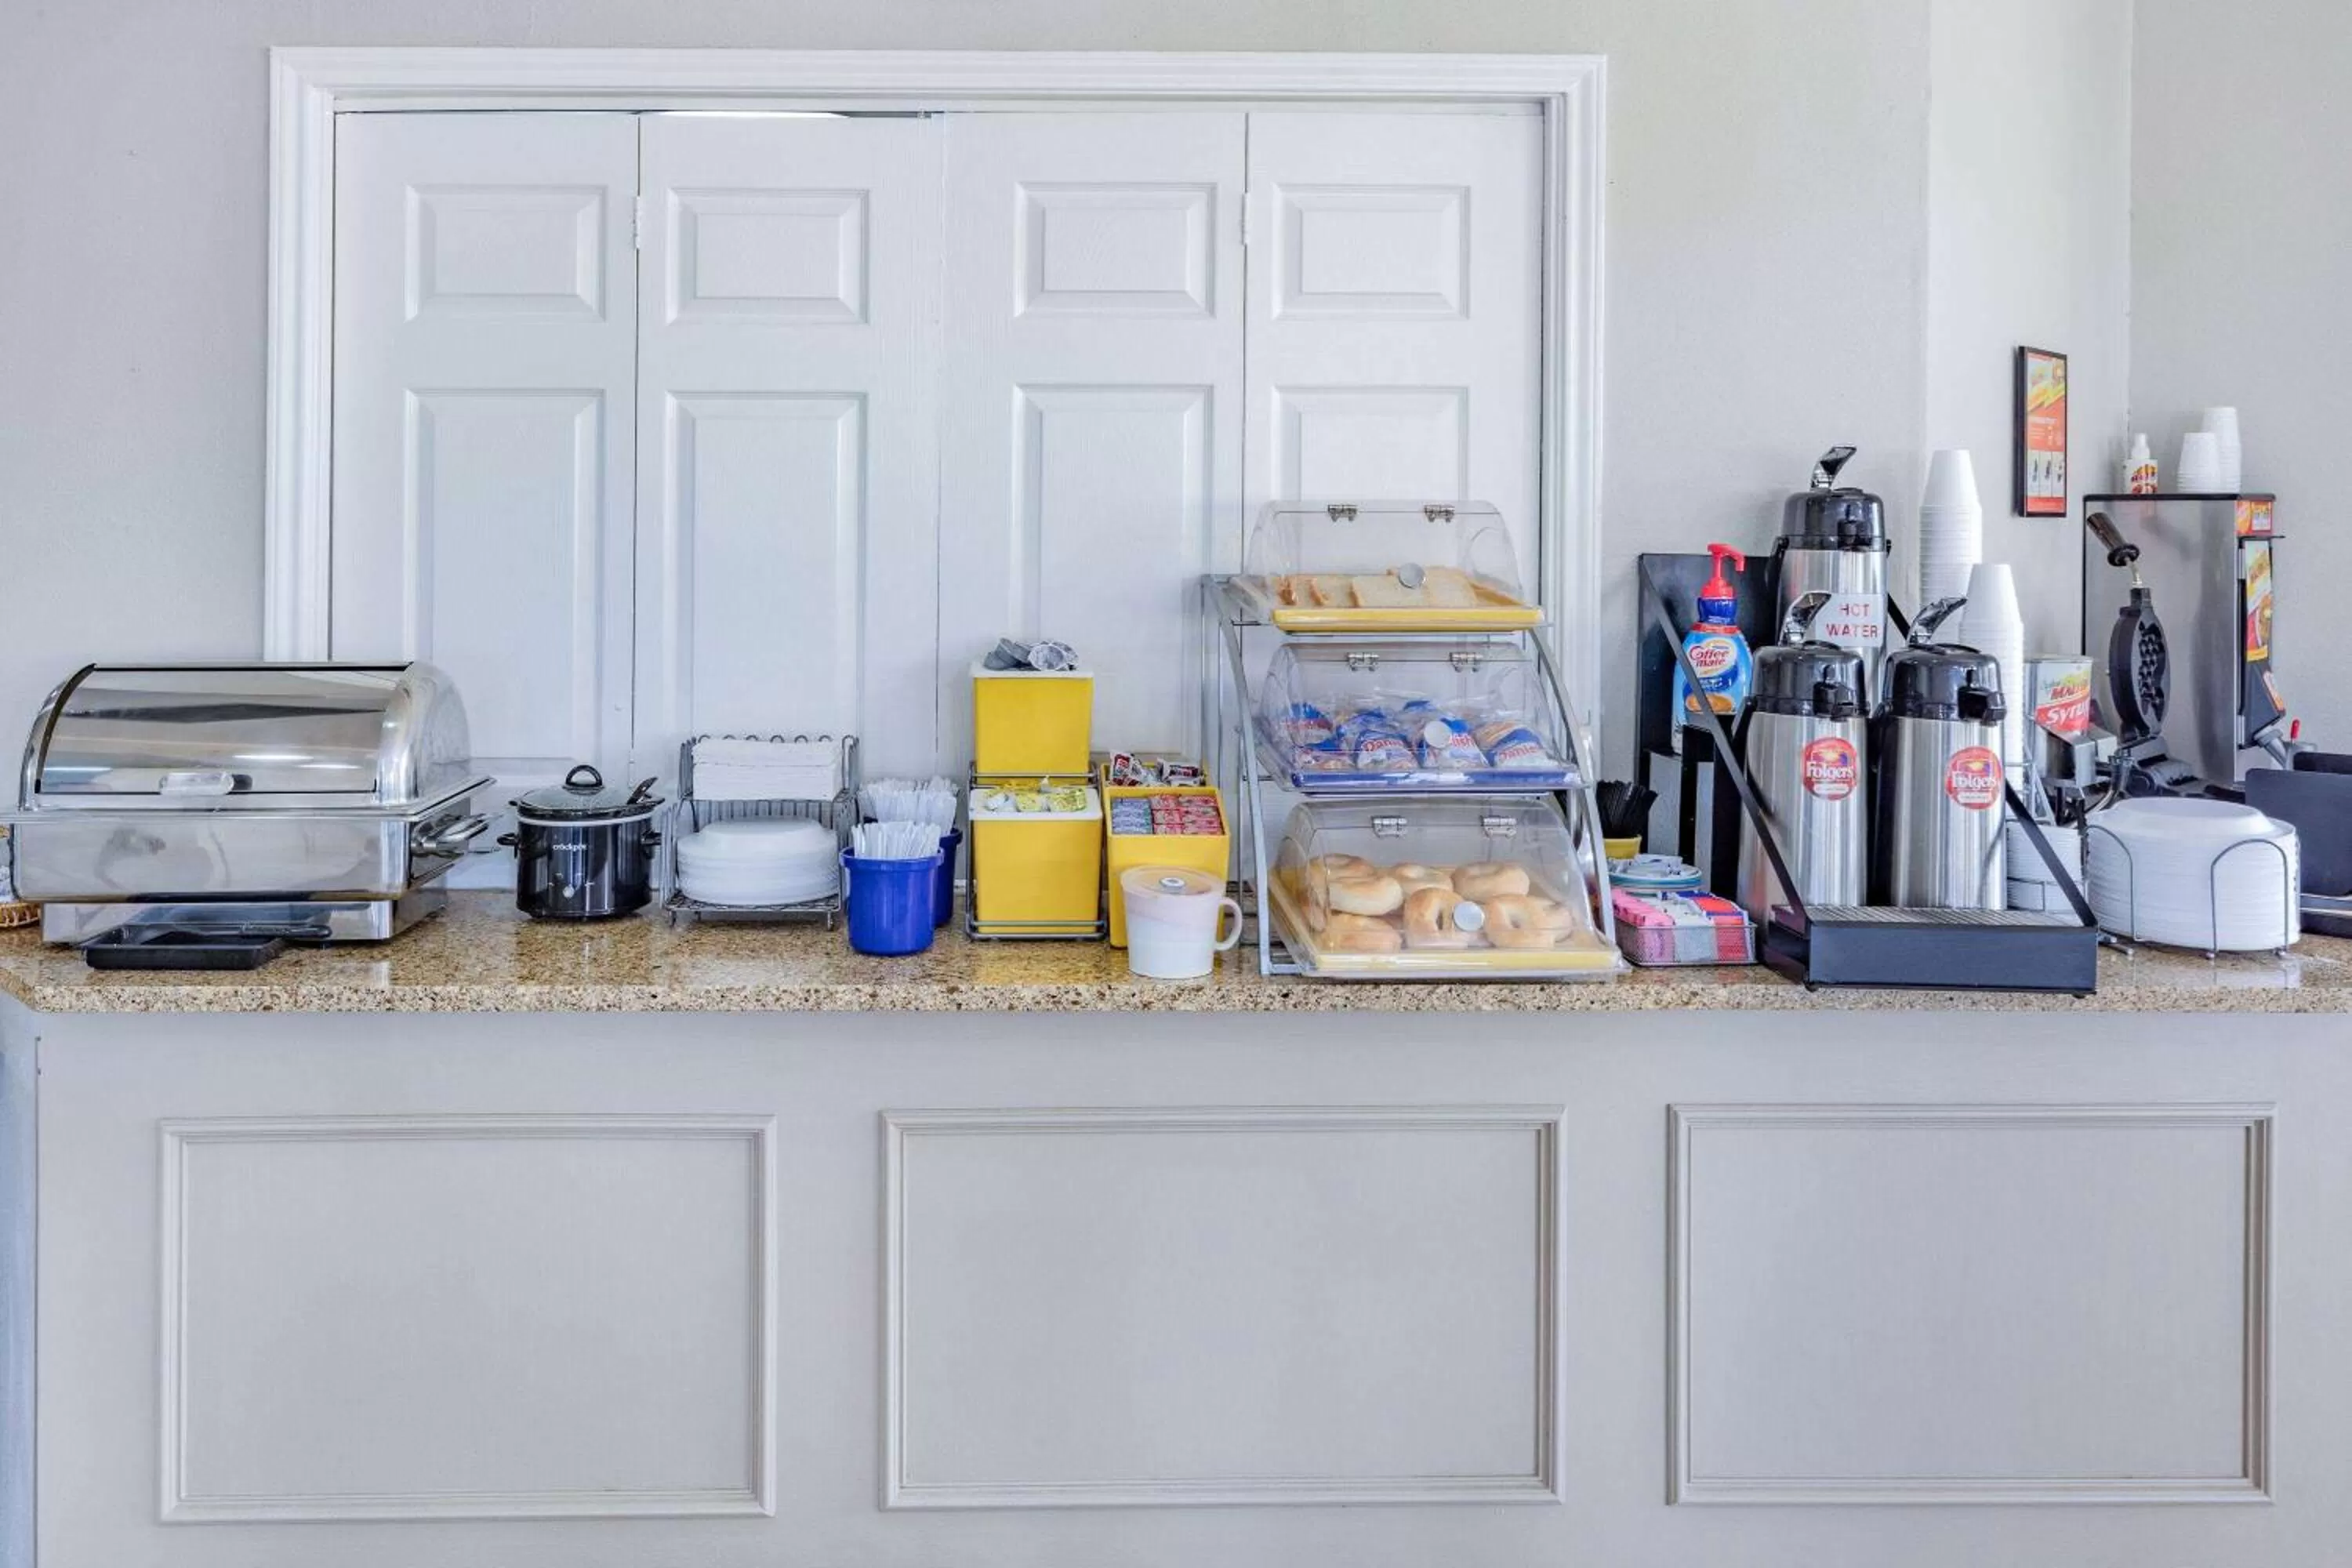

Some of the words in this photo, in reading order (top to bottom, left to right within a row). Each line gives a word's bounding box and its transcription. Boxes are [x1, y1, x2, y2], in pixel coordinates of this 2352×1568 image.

[1839, 603, 1870, 616] HOT
[1825, 623, 1878, 638] WATER
[1690, 645, 1730, 660] Coffee
[1696, 659, 1726, 667] mate
[1806, 761, 1856, 782] Folgers
[1952, 771, 1997, 789] Folgers
